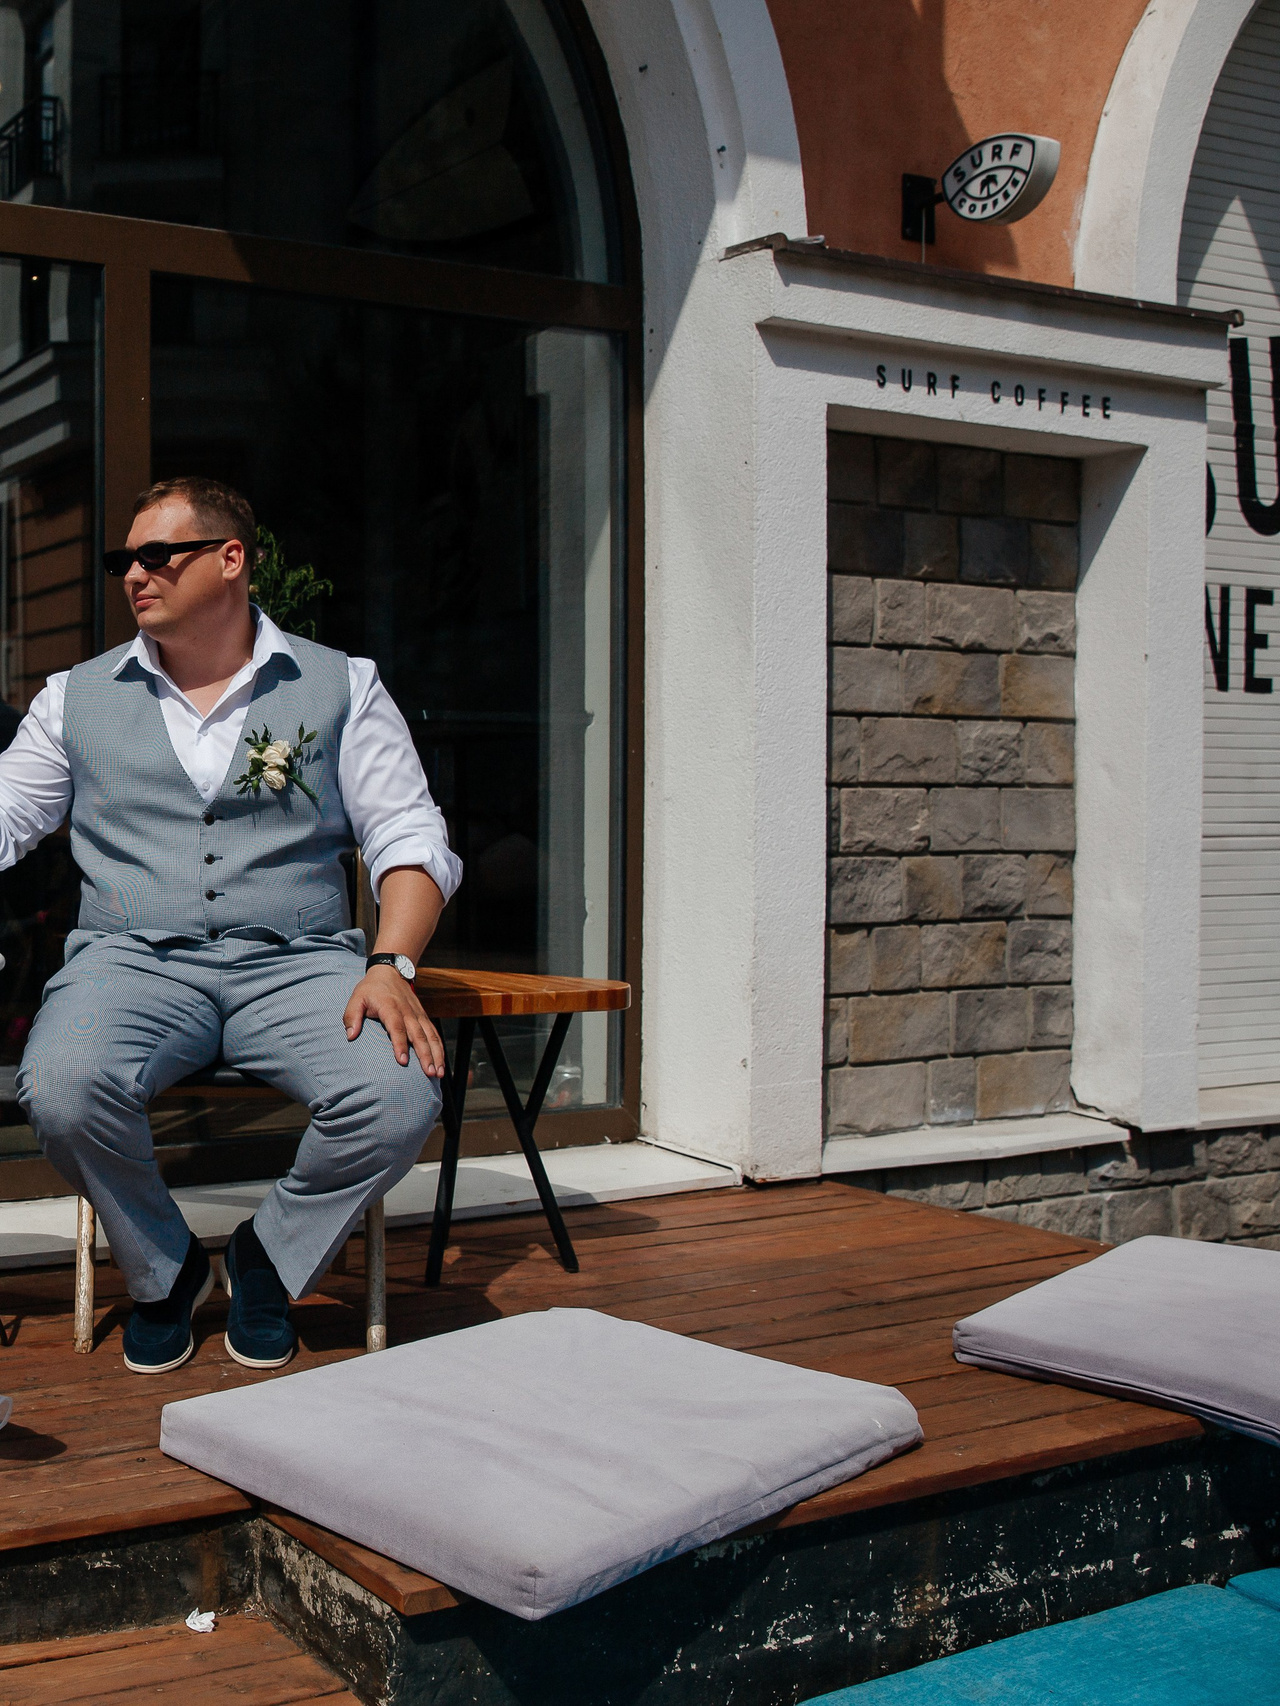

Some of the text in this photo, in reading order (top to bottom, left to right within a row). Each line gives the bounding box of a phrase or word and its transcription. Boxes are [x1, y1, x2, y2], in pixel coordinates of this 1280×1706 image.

[952, 143, 1023, 184] SURF
[958, 177, 1021, 215] COFFEE
[876, 364, 1111, 419] SURF COFFEE
[1206, 337, 1280, 537] U
